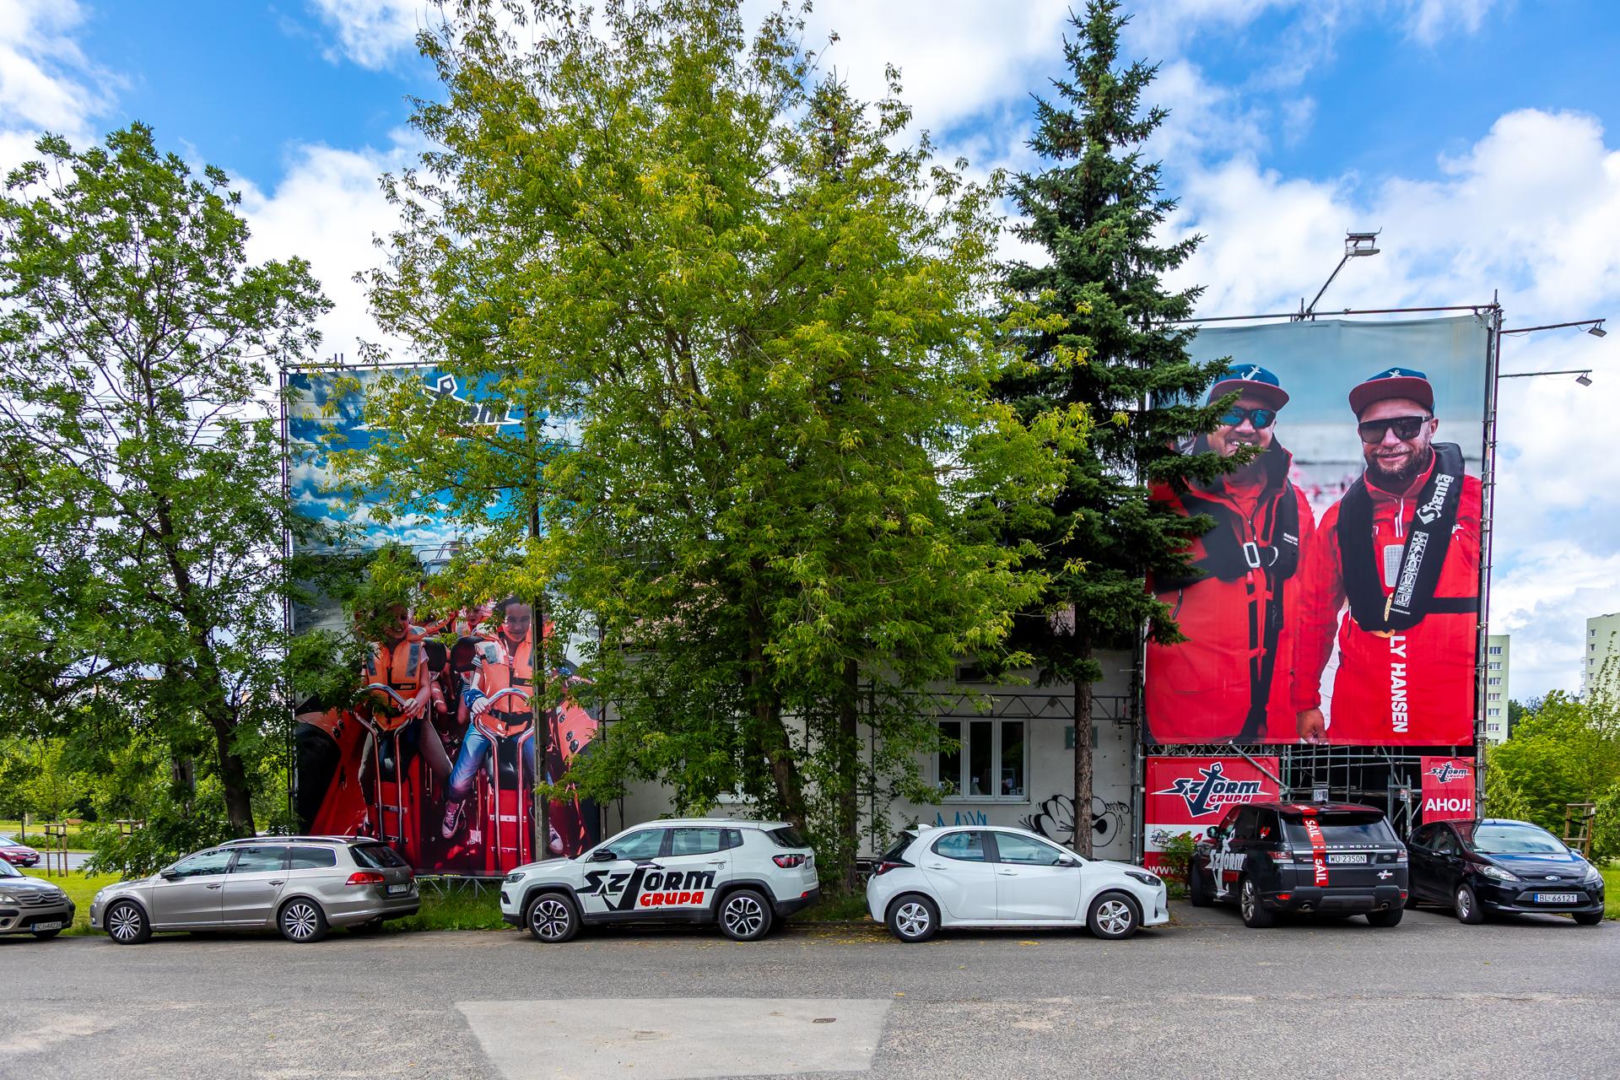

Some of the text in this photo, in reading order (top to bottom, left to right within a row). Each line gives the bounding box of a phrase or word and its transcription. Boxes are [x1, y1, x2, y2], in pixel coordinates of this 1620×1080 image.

[1390, 662, 1408, 733] HANSEN
[1209, 794, 1252, 803] GRUPA
[1425, 798, 1471, 812] AHOJ!
[1305, 819, 1321, 838] SAIL
[1315, 858, 1327, 883] SAIL
[640, 891, 705, 906] GRUPA
